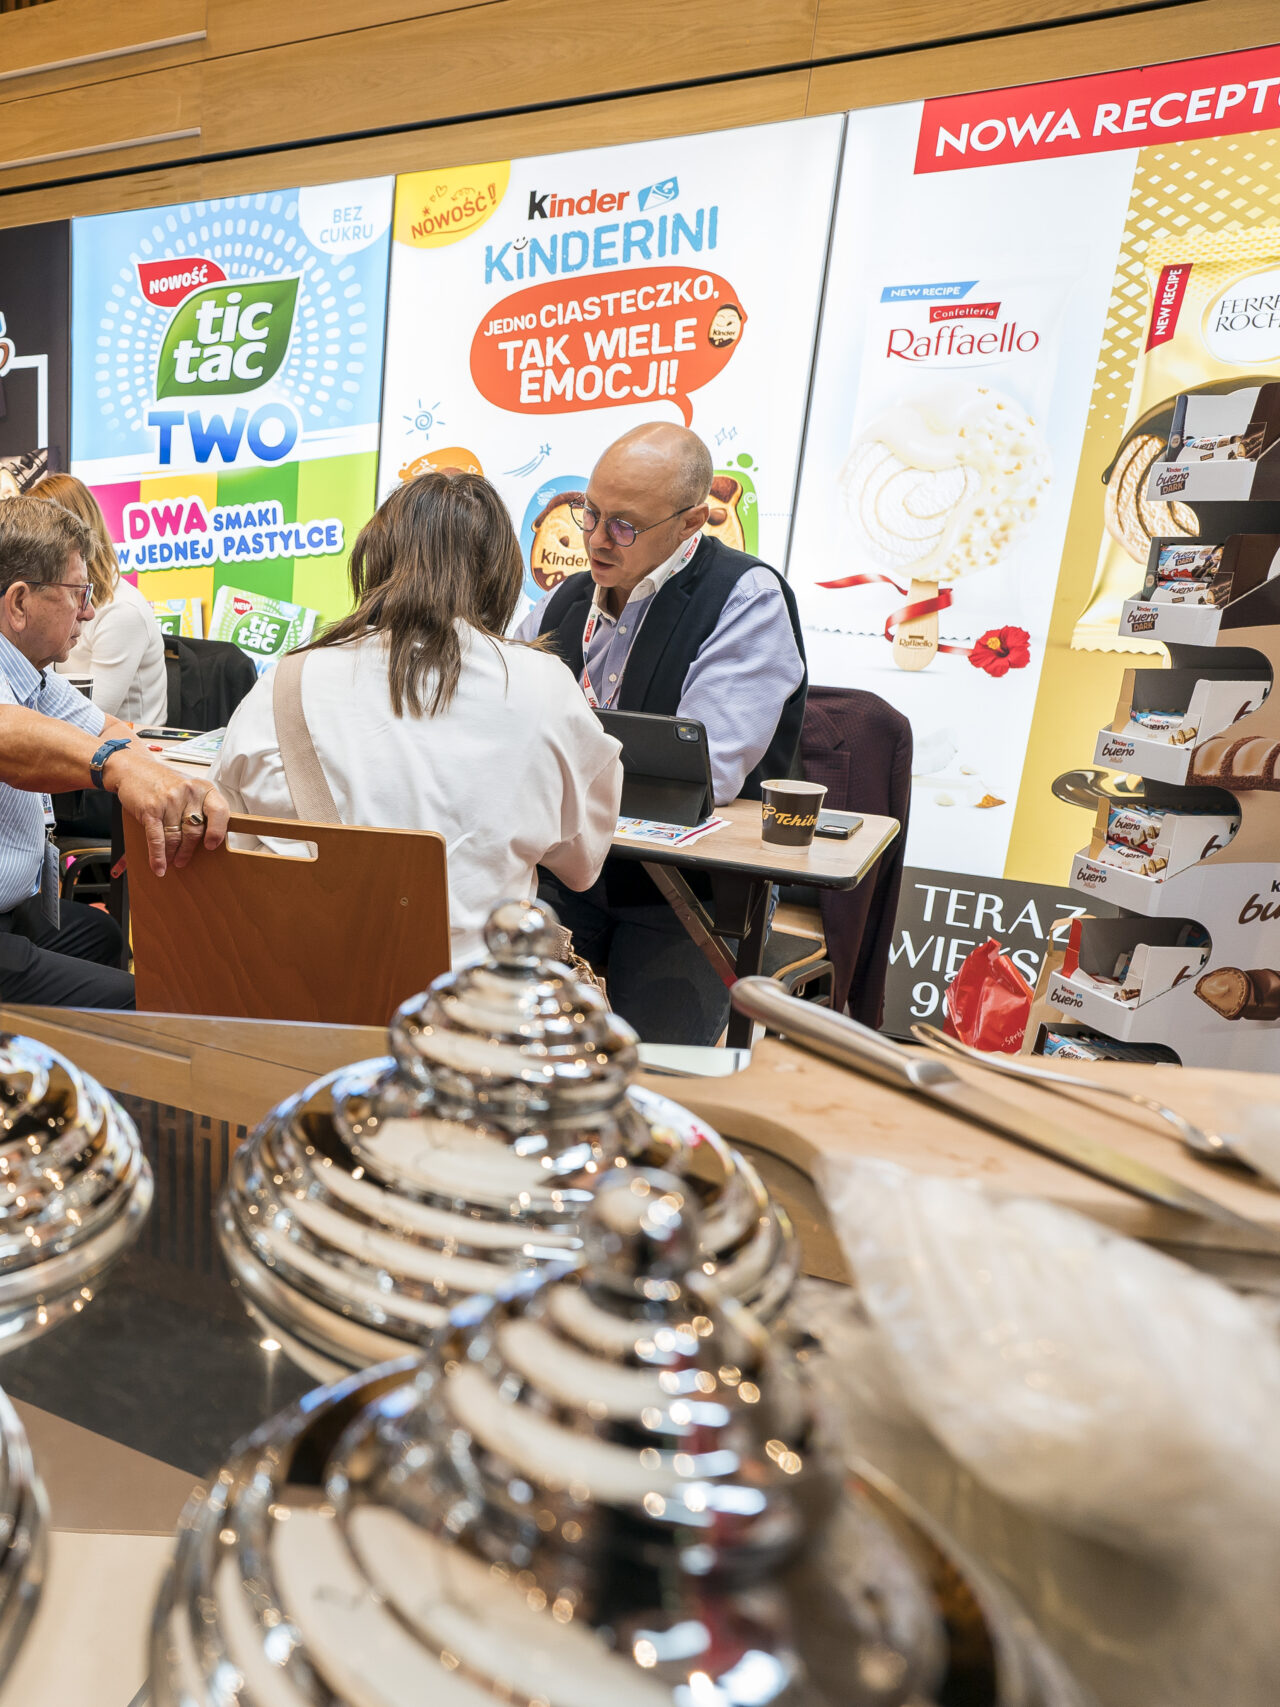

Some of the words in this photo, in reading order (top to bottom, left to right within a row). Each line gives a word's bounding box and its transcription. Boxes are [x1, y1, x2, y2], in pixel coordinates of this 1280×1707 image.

[935, 108, 1081, 157] NOWA
[1092, 77, 1280, 137] RECEPT
[333, 206, 362, 223] BEZ
[528, 188, 630, 220] Kinder
[319, 224, 373, 244] CUKRU
[149, 265, 209, 294] NOWOŚĆ
[891, 288, 919, 298] NEW
[922, 286, 961, 297] RECIPE
[1161, 268, 1183, 306] RECIPE
[195, 292, 273, 345] tic
[484, 313, 537, 337] JEDNO
[540, 275, 720, 328] CIASTECZKO,
[933, 306, 995, 320] Confetteria
[1154, 307, 1173, 336] NEW
[498, 337, 570, 371] TAK
[583, 318, 697, 362] WIELE
[886, 322, 1040, 362] Raffaello
[173, 340, 267, 384] tac
[519, 360, 679, 404] EMOCJI!
[148, 403, 298, 465] TWO
[1155, 472, 1190, 487] bueno
[1162, 481, 1184, 495] DARK
[129, 502, 208, 539] DWA
[213, 508, 277, 531] SMAKI
[135, 539, 214, 564] JEDNEJ
[223, 526, 338, 557] PASTYLCE
[249, 615, 281, 639] tic
[1127, 611, 1159, 623] bueno
[1133, 621, 1153, 632] DARK
[237, 627, 278, 652] tac
[1101, 743, 1135, 757] bueno
[1115, 818, 1141, 831] bueno
[1076, 868, 1107, 884] bueno
[914, 884, 1088, 944] TERAZ
[1051, 989, 1084, 1009] bueno
